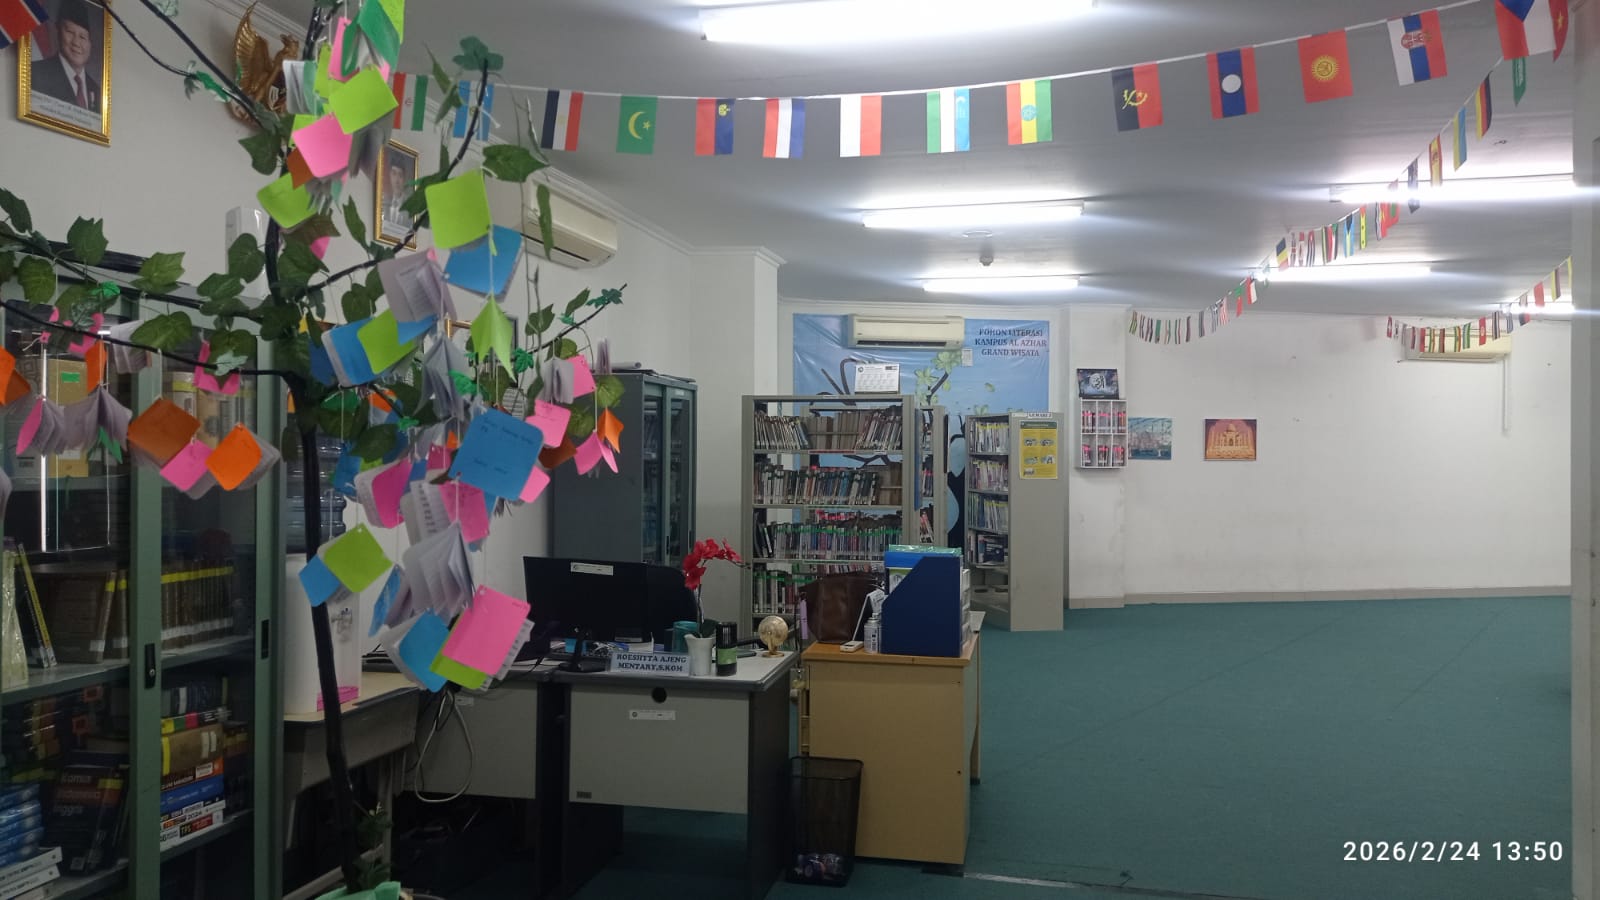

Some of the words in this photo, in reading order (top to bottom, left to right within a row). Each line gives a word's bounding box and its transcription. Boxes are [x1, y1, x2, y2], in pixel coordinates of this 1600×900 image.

[979, 328, 1007, 336] POHON
[1008, 329, 1043, 337] LITERASI
[975, 338, 1008, 346] KAMPUS
[1009, 339, 1019, 347] AL
[981, 348, 1008, 356] GRAND
[1010, 349, 1040, 357] WISATA
[660, 655, 687, 663] AJENG
